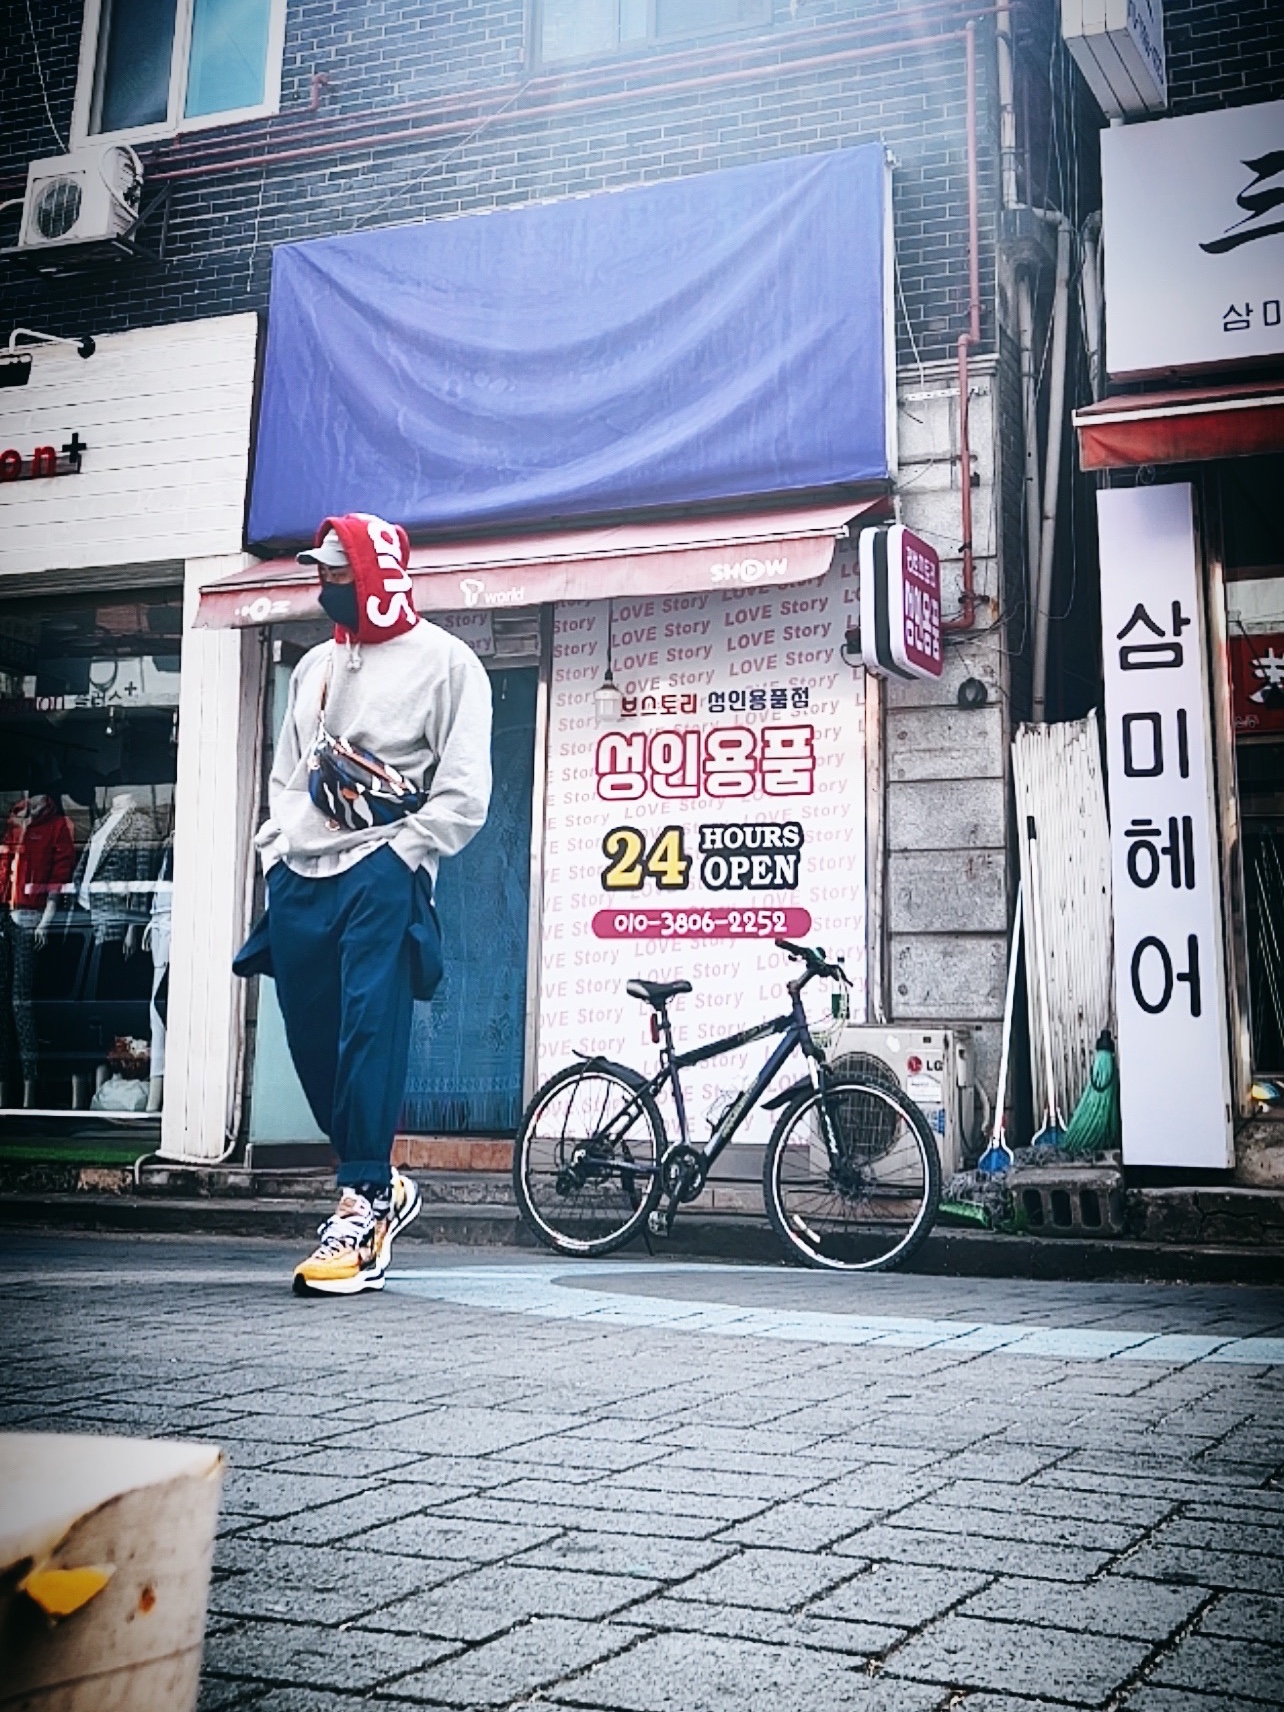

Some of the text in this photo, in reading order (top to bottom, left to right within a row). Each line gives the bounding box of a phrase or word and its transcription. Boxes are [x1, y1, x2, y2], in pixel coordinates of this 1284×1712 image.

[356, 512, 417, 627] Sup
[709, 557, 788, 583] SHOW
[484, 586, 525, 604] world
[661, 594, 709, 614] Story
[553, 597, 829, 658] Story LOVE Story LOVE Story
[555, 622, 832, 682] Story LOVE Story LOVE Story
[668, 669, 715, 687] Story
[729, 653, 777, 677] LOVE
[785, 648, 834, 666] Story
[620, 687, 808, 717] 브스토리 성인용품점
[595, 724, 816, 801] 성인용품
[565, 812, 609, 828] Story
[624, 801, 671, 819] LOVE
[801, 804, 850, 819] Story
[1116, 600, 1201, 1018] 삼미헤어
[805, 828, 853, 844] Story
[604, 828, 690, 889] 24
[701, 826, 800, 849] HOURS
[703, 854, 797, 887] OPEN
[806, 855, 857, 873] Story
[809, 884, 859, 902] Story
[613, 911, 788, 937] 010-3806-2252
[813, 915, 863, 932] Story
[573, 949, 619, 966] Story
[575, 978, 621, 995] Story
[692, 962, 740, 979] Story
[577, 1007, 624, 1025] Story
[694, 992, 743, 1009] Story
[926, 1060, 944, 1072] LG
